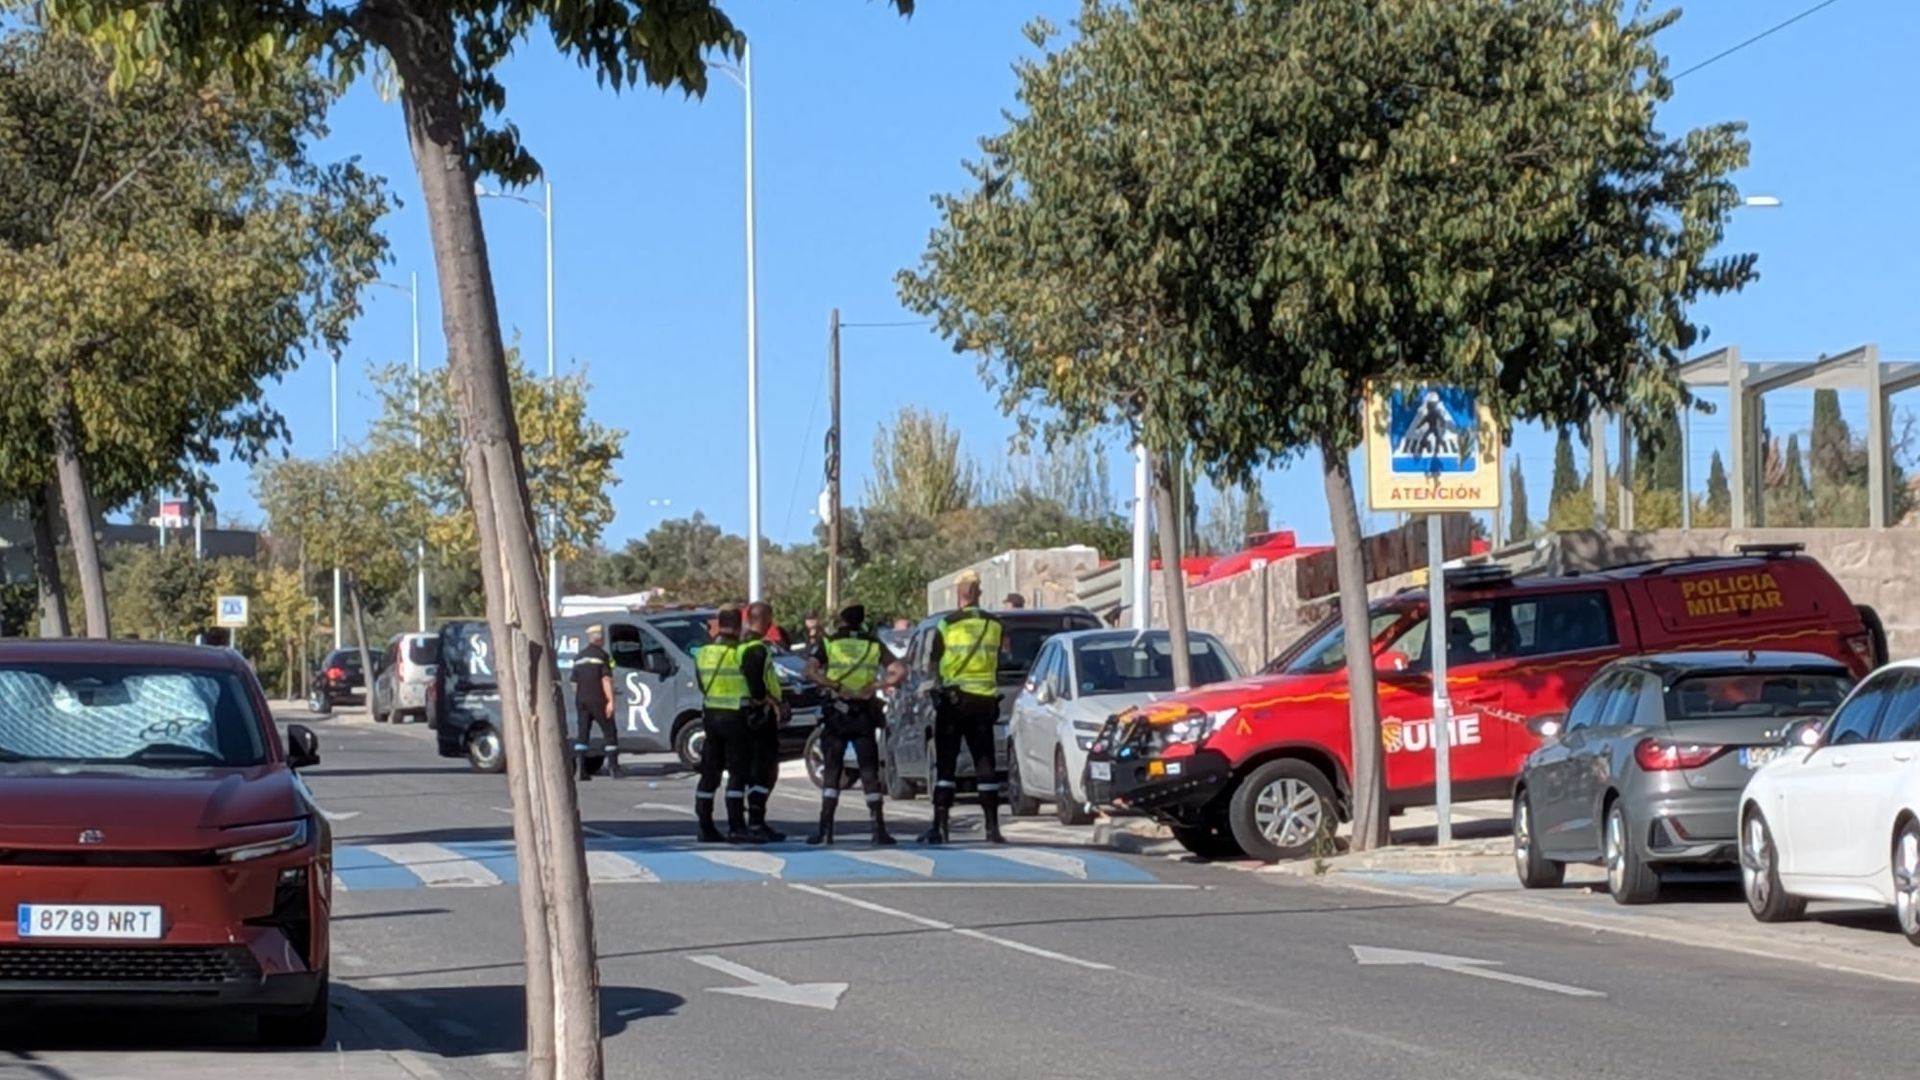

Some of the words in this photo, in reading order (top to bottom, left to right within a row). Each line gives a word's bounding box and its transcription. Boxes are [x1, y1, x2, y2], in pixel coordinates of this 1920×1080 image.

[1390, 484, 1481, 501] ATENCIÓN
[1681, 573, 1778, 599] POLICIA
[1685, 590, 1784, 617] MILITAR
[39, 909, 99, 932] 8789
[107, 911, 151, 932] NRT
